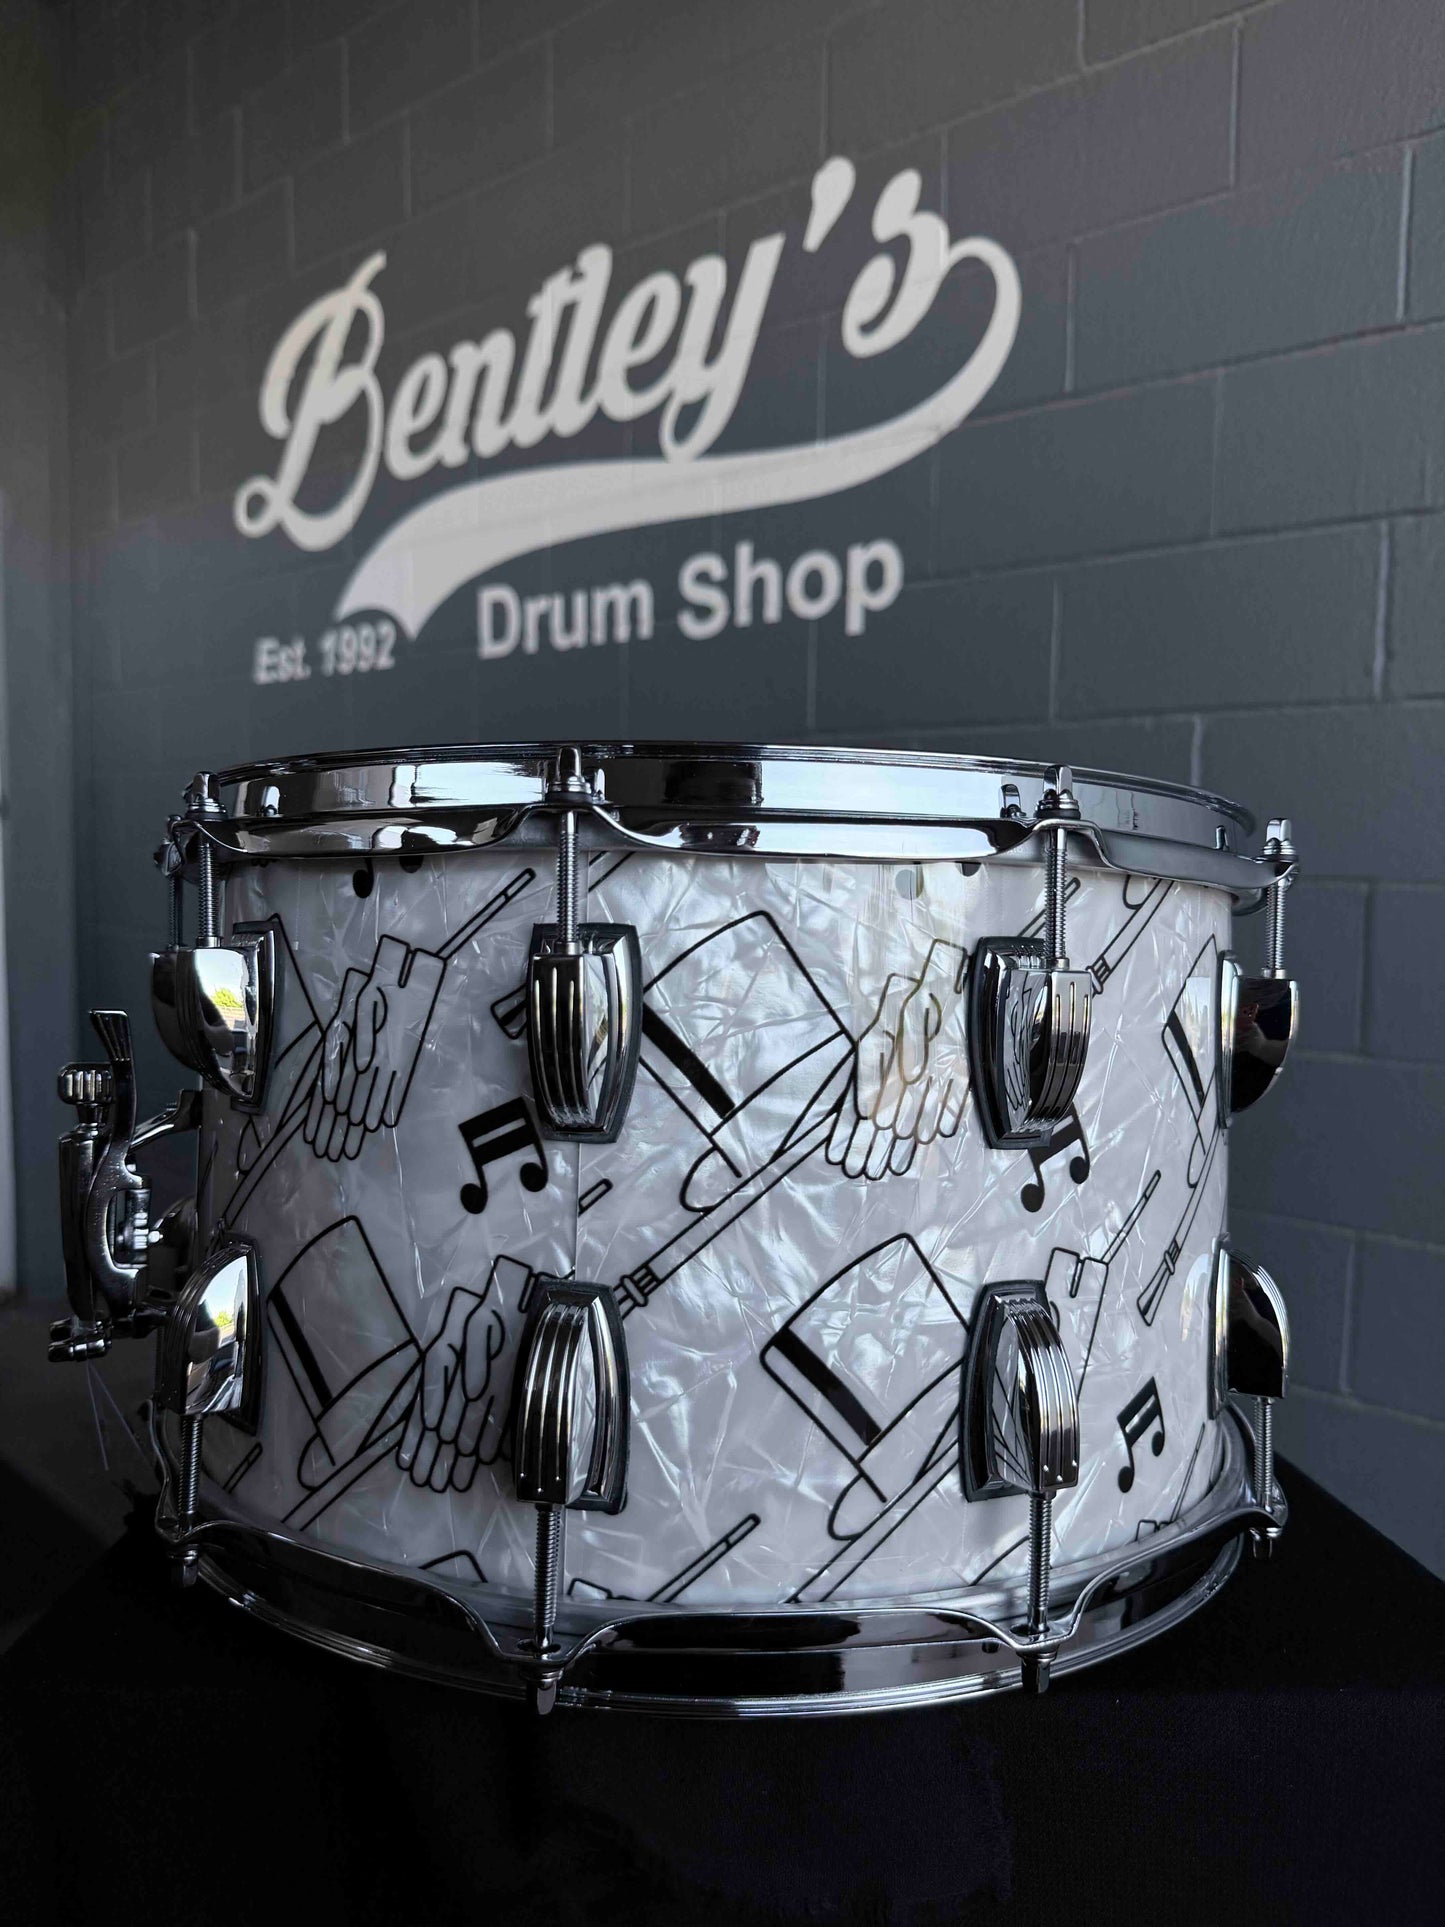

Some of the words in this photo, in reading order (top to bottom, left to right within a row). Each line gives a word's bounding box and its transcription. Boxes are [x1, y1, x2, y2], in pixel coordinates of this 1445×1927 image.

[233, 156, 1022, 551] Bentley's
[253, 636, 312, 685] Est.
[320, 620, 397, 676] 1992
[477, 579, 654, 659] Drum
[677, 540, 904, 639] Shop
